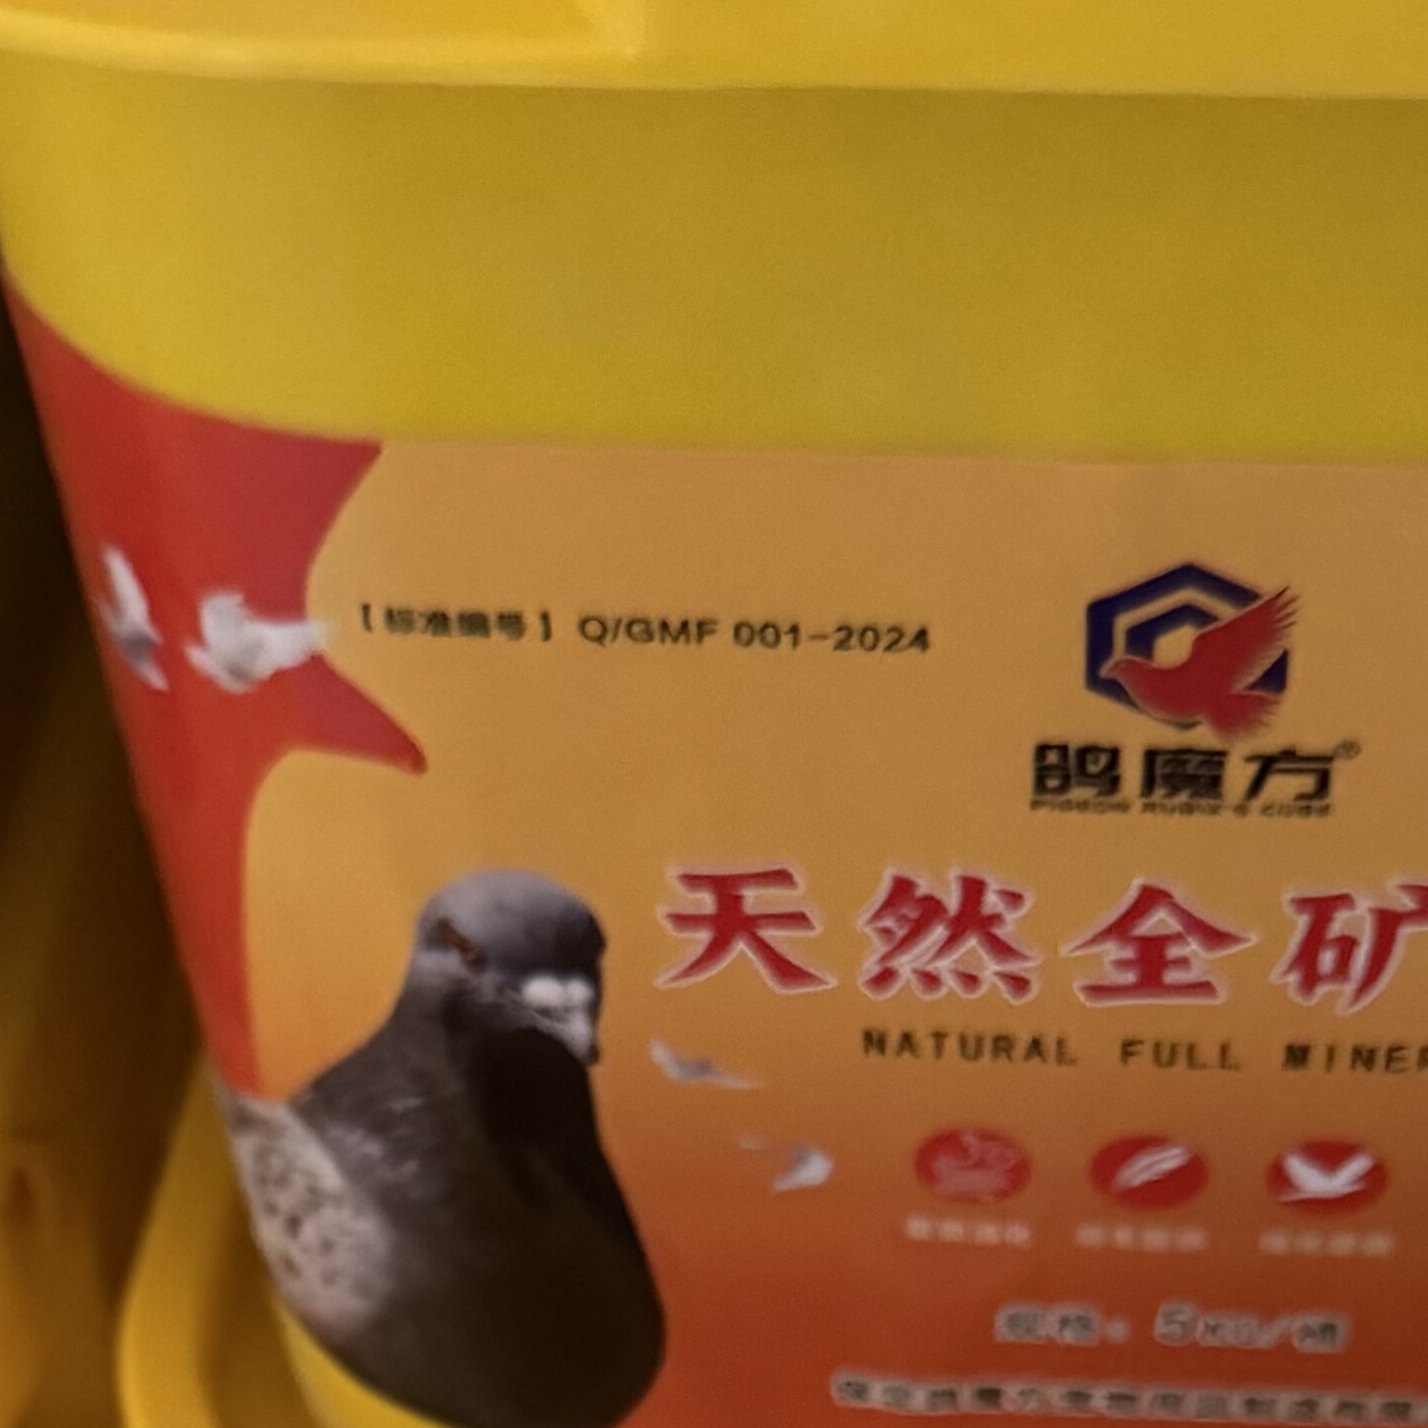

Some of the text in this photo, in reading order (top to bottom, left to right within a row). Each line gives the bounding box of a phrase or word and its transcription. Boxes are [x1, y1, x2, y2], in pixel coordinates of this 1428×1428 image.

[577, 614, 719, 647] Q/GMF
[732, 619, 932, 654] 001-2024
[1034, 742, 1335, 801] 鸽魔方
[862, 1026, 1079, 1068] NATURAL
[1118, 1037, 1242, 1071] FULL
